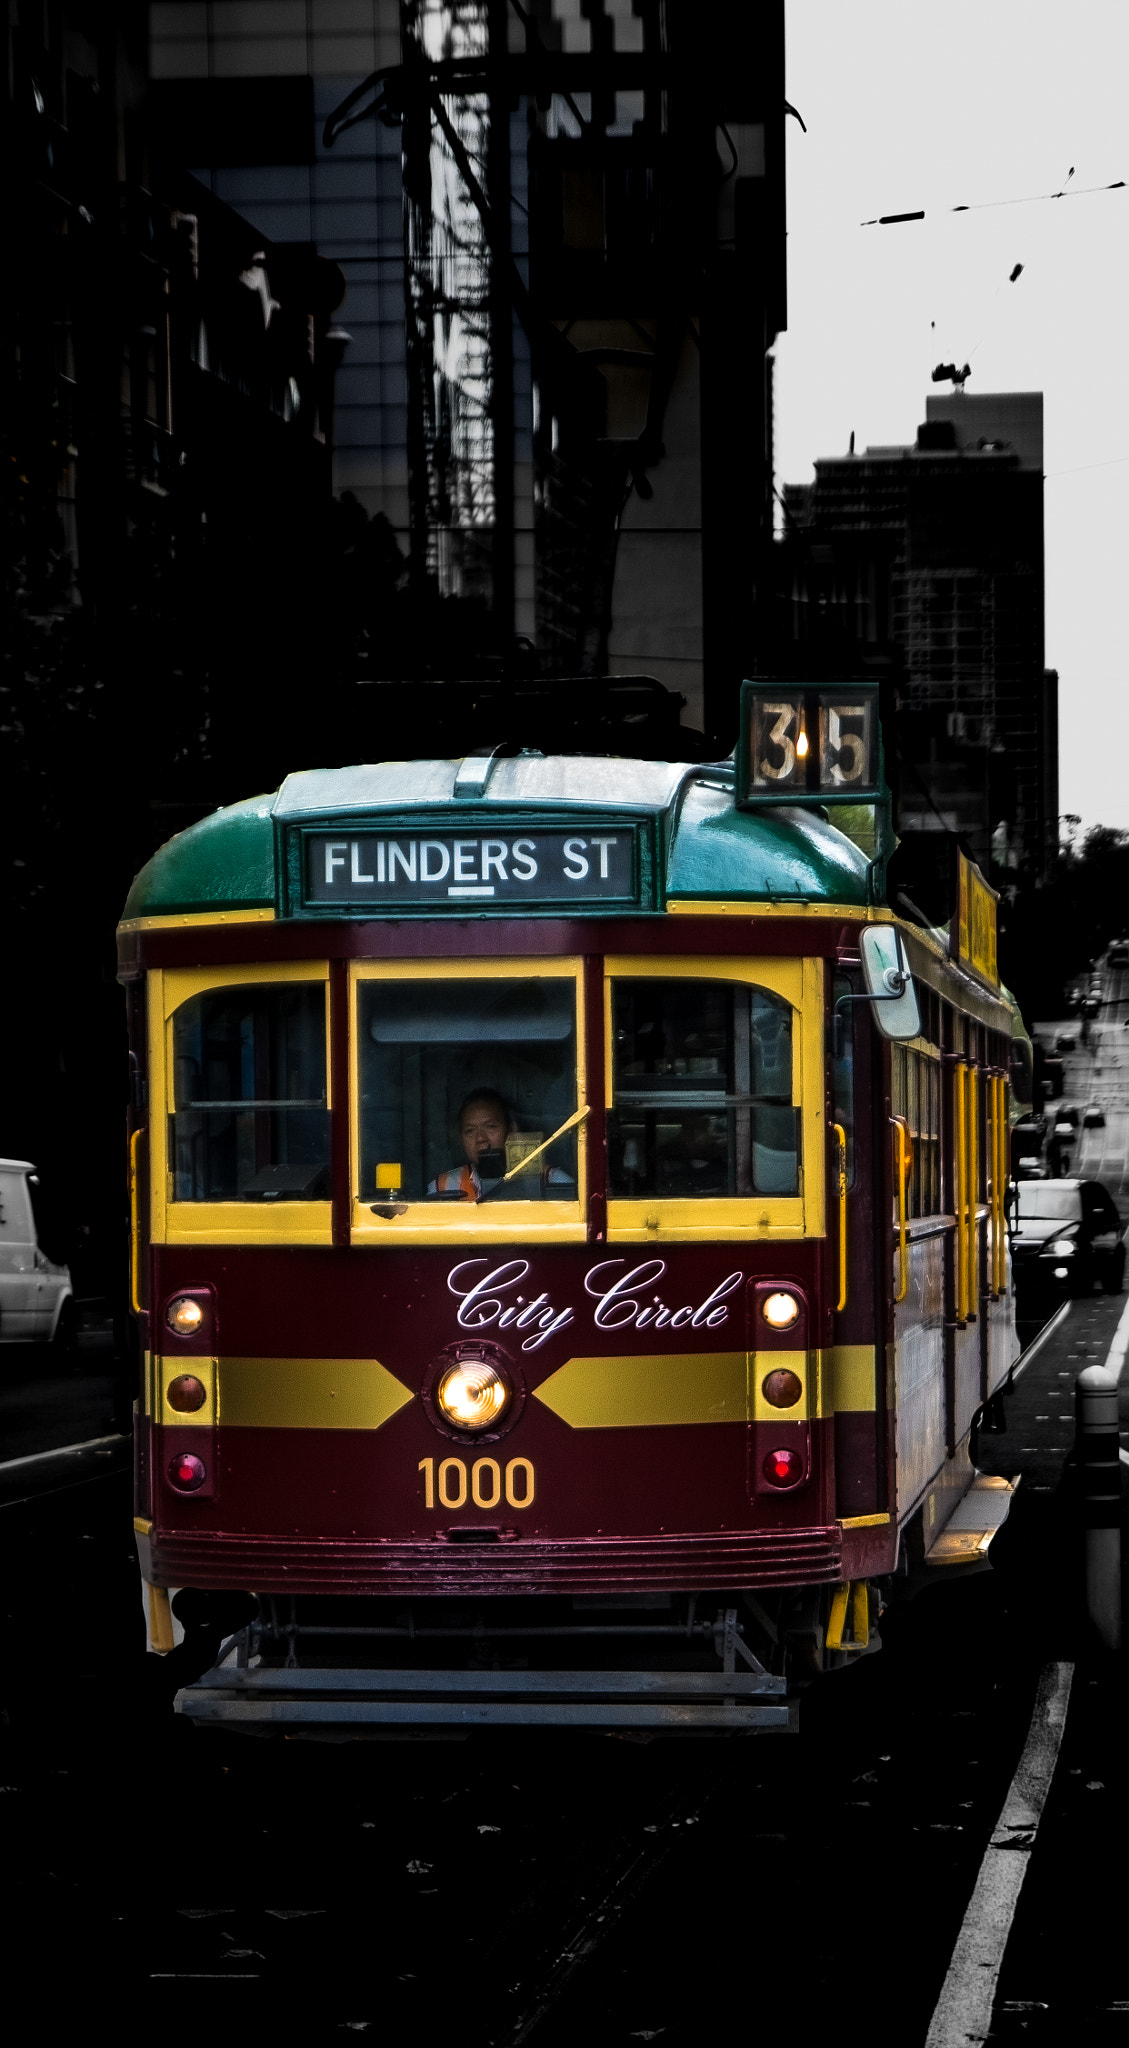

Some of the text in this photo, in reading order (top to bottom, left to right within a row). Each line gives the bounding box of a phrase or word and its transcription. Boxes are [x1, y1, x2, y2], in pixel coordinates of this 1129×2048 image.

[760, 703, 866, 781] 35
[325, 837, 617, 883] FLINDERS ST
[447, 1258, 743, 1350] City Circle
[418, 1457, 535, 1508] 1000
